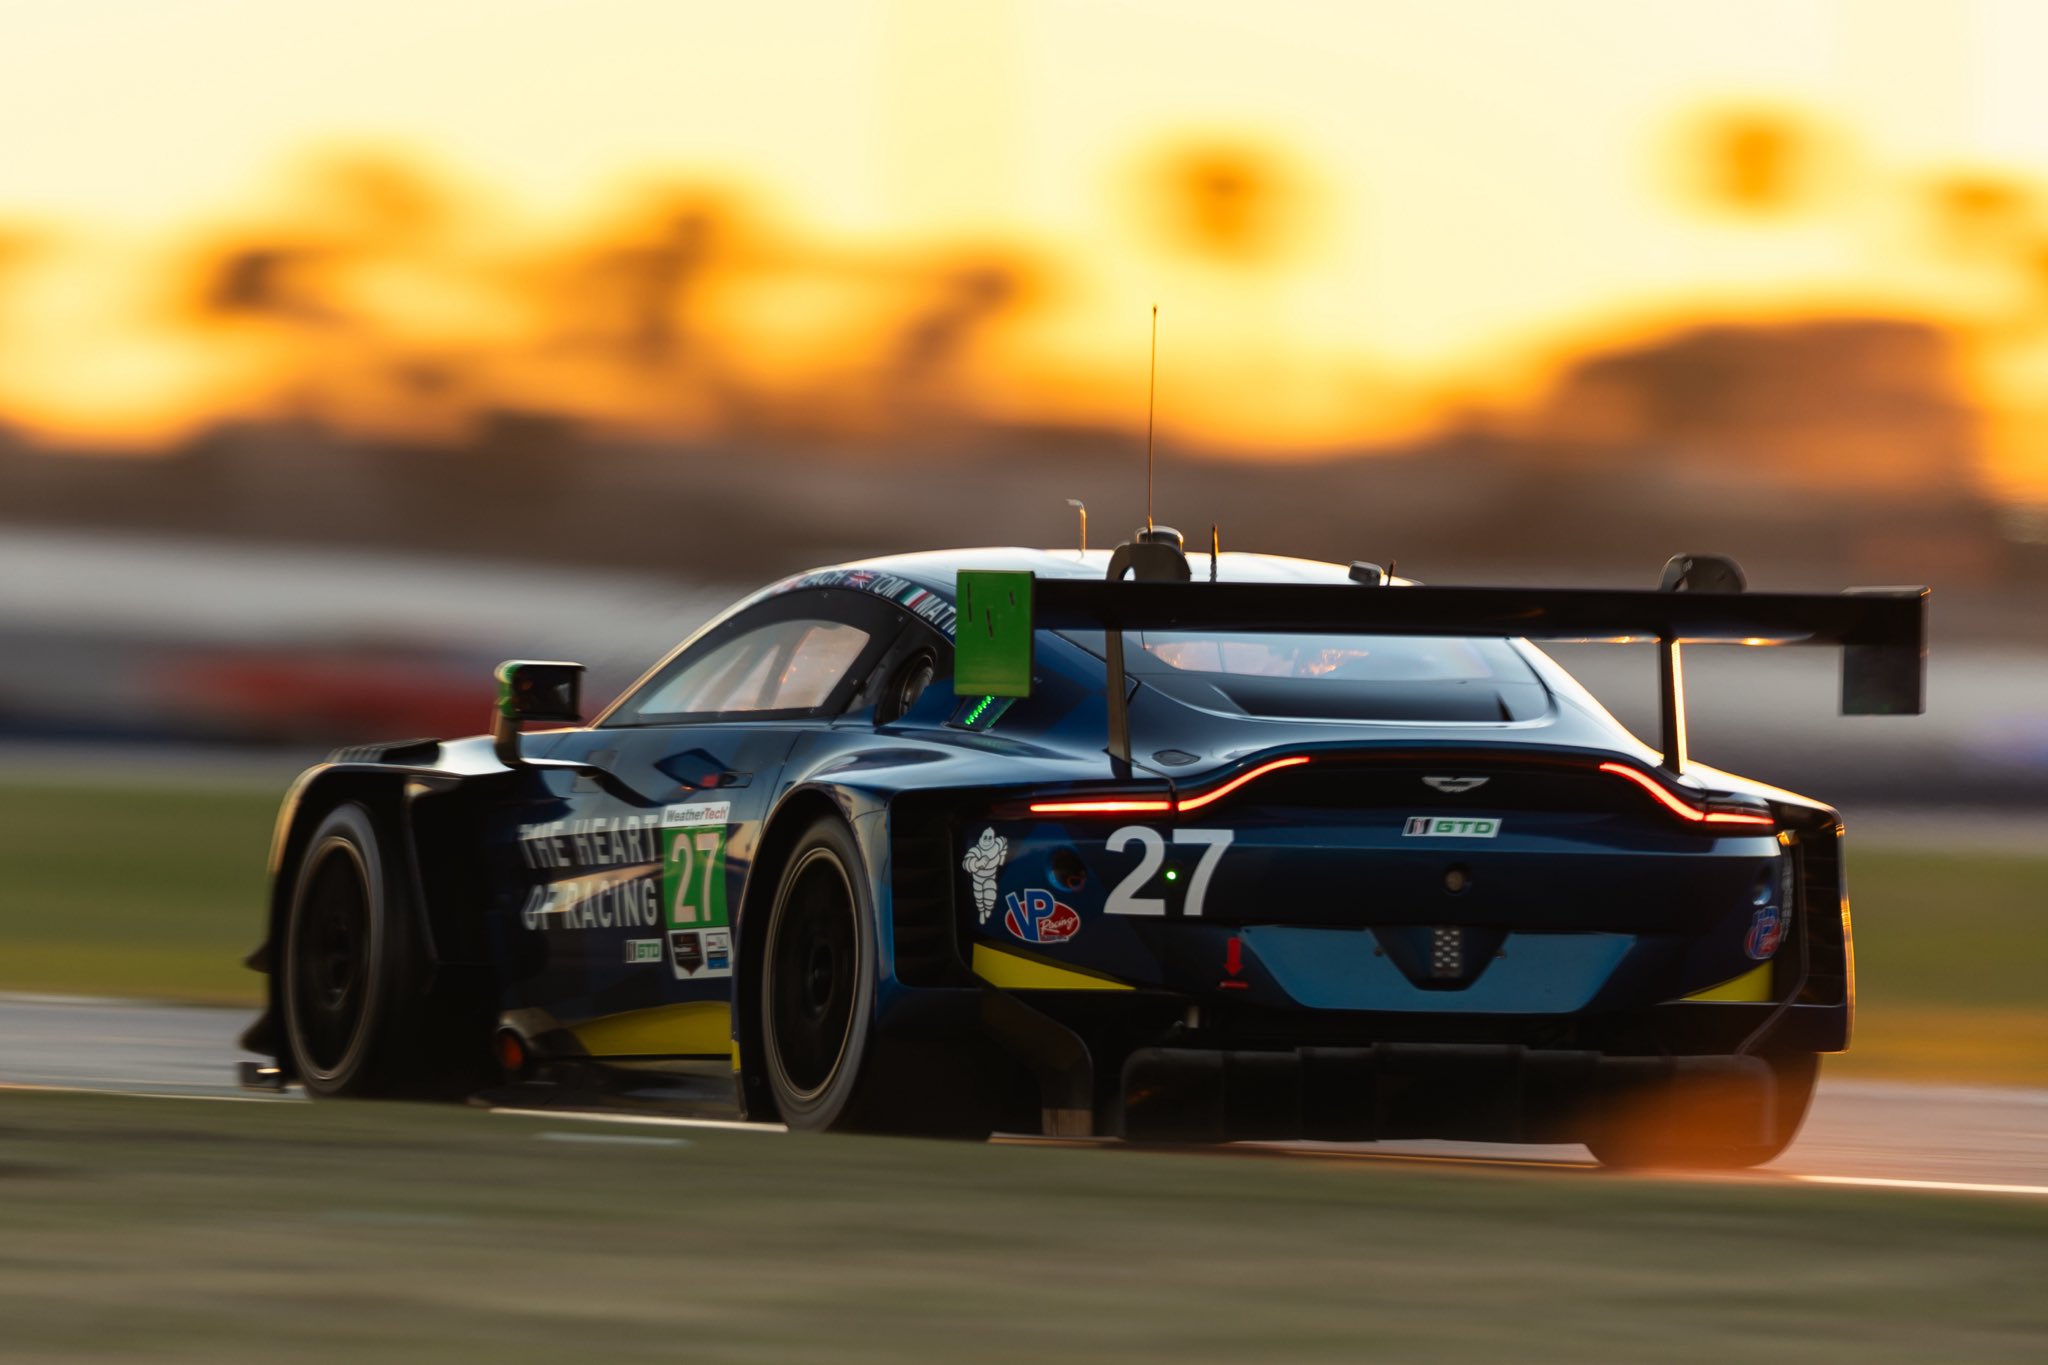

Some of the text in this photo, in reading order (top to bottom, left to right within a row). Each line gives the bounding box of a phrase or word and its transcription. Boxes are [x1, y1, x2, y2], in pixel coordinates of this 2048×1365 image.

[866, 573, 912, 599] TOM
[913, 592, 956, 636] MATT
[666, 806, 729, 822] WeatherTech
[1433, 820, 1494, 834] GTD
[517, 815, 660, 869] THE HEART
[672, 832, 720, 924] 27
[1104, 825, 1234, 916] 27
[521, 877, 658, 931] OF RACING
[1005, 888, 1056, 943] VP
[1039, 916, 1077, 936] Racing
